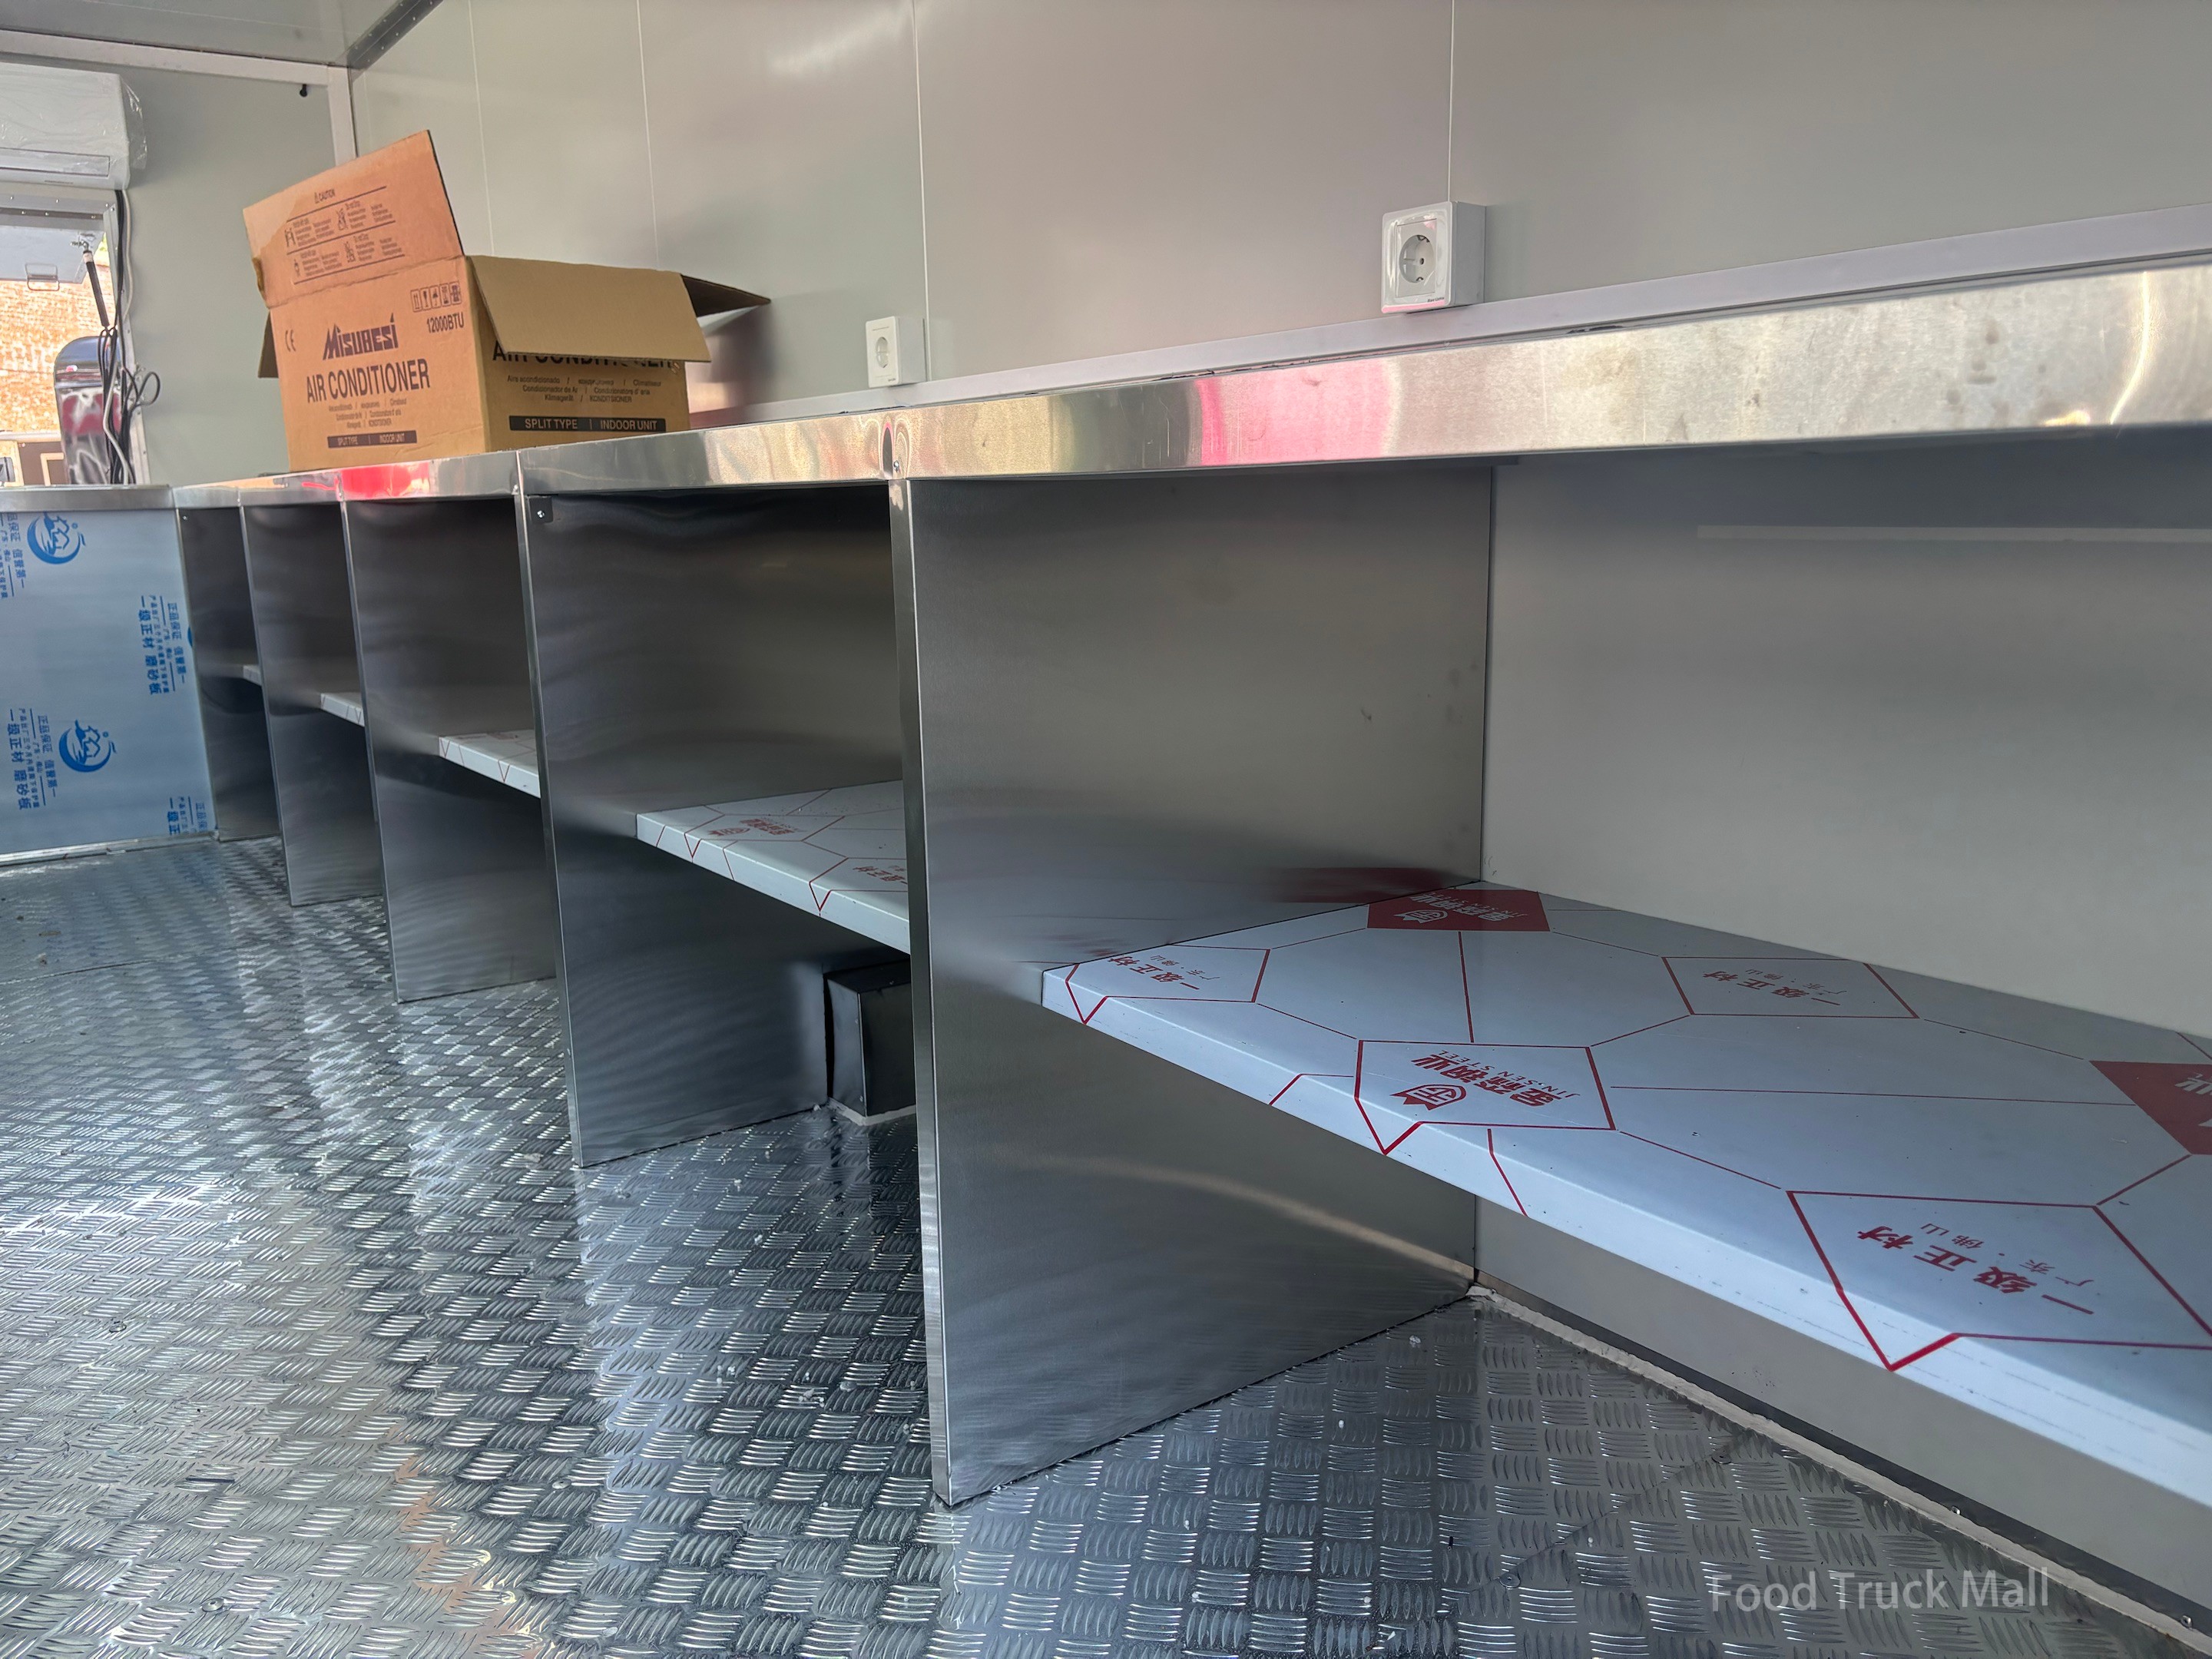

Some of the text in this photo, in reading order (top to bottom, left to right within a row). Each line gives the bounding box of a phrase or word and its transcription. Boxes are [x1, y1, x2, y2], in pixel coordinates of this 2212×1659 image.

[426, 312, 464, 333] 12000BTU
[306, 358, 430, 403] AIR CONDITIONER
[525, 419, 578, 430] SPLIT TYPE
[600, 419, 657, 430] INDOOR UNIT
[1108, 956, 1200, 990] 一级正材
[1703, 971, 1840, 1005] 一级正材
[1438, 1050, 1495, 1071] STEEL
[1857, 1226, 2094, 1315] 一级正材
